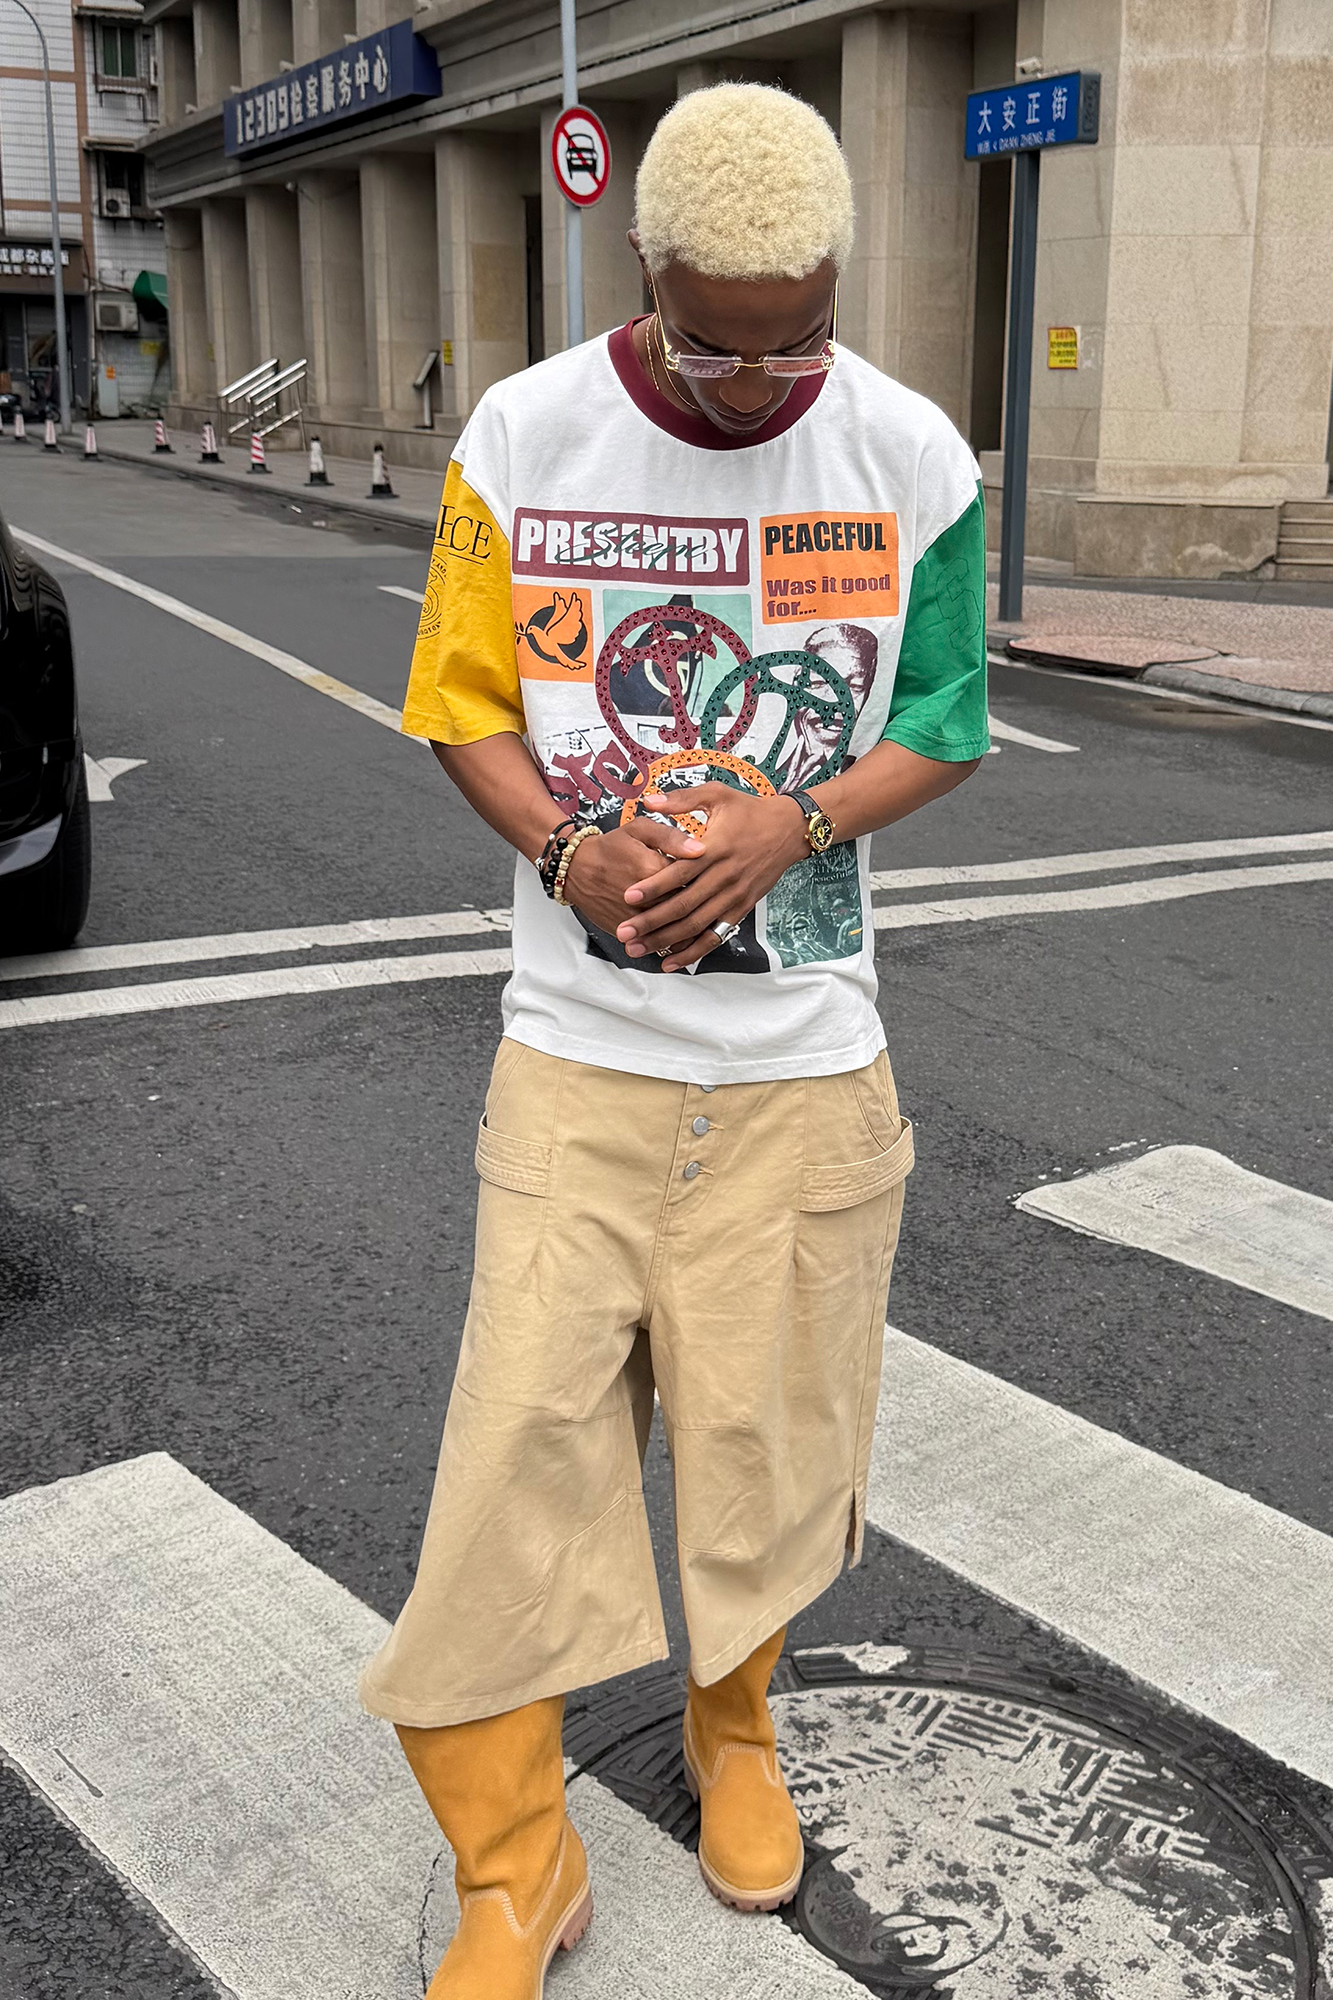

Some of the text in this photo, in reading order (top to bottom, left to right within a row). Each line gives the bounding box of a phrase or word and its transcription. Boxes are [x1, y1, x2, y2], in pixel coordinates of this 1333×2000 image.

[236, 44, 388, 145] 12309检察服务中心
[977, 86, 1068, 134] 大安正街
[765, 521, 886, 555] PEACEFUL
[766, 574, 890, 597] Was it good
